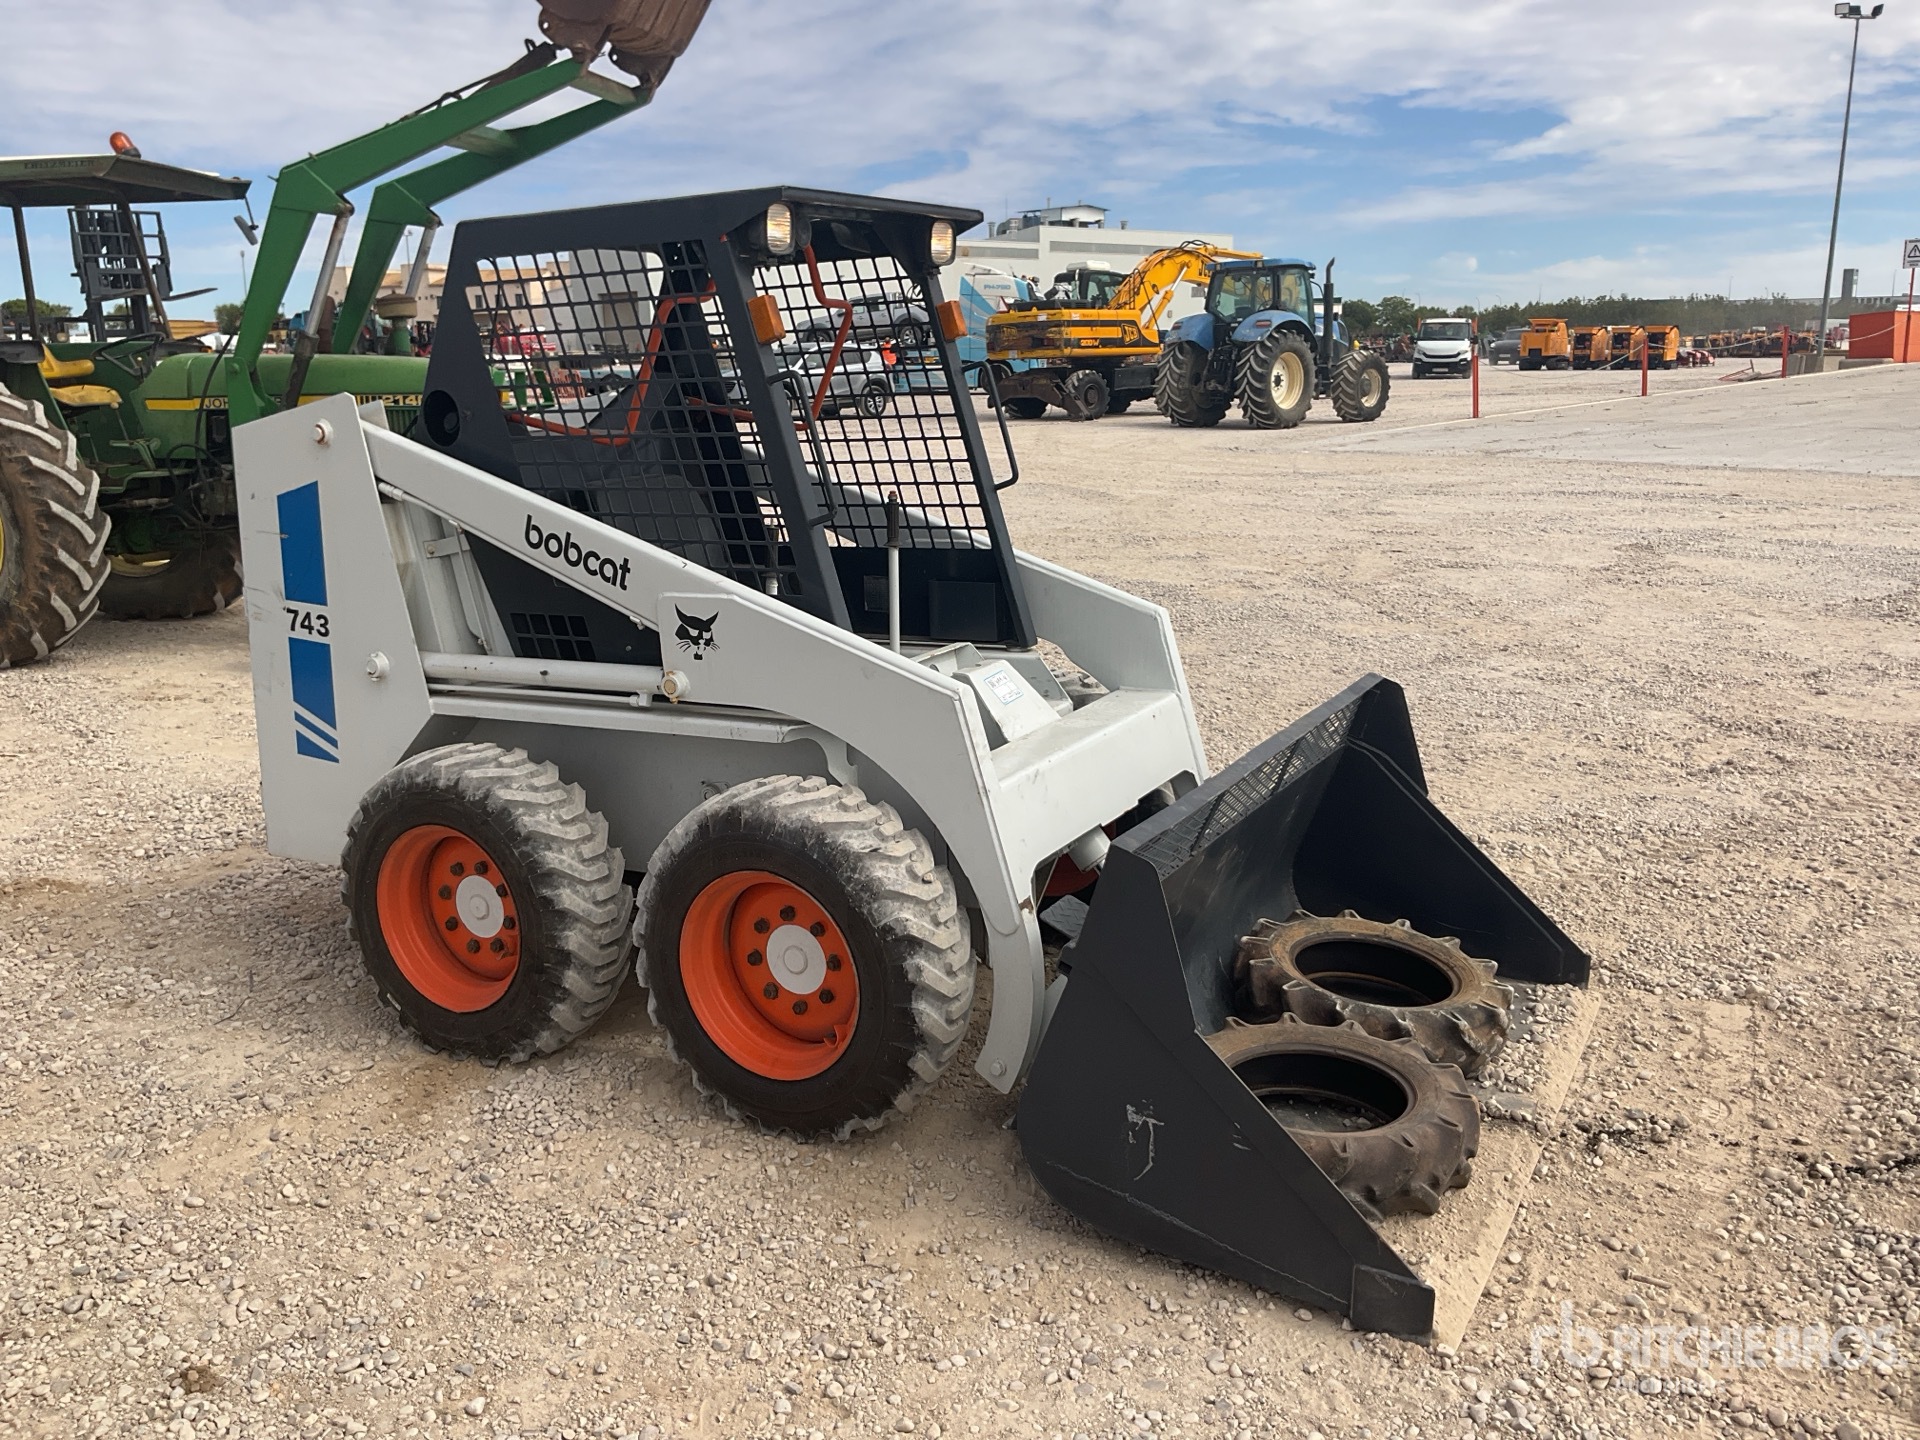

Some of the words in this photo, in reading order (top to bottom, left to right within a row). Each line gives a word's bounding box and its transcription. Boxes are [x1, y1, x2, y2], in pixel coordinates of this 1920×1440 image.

[1123, 325, 1138, 343] JCB
[525, 514, 631, 591] bobcat
[286, 607, 330, 638] 743
